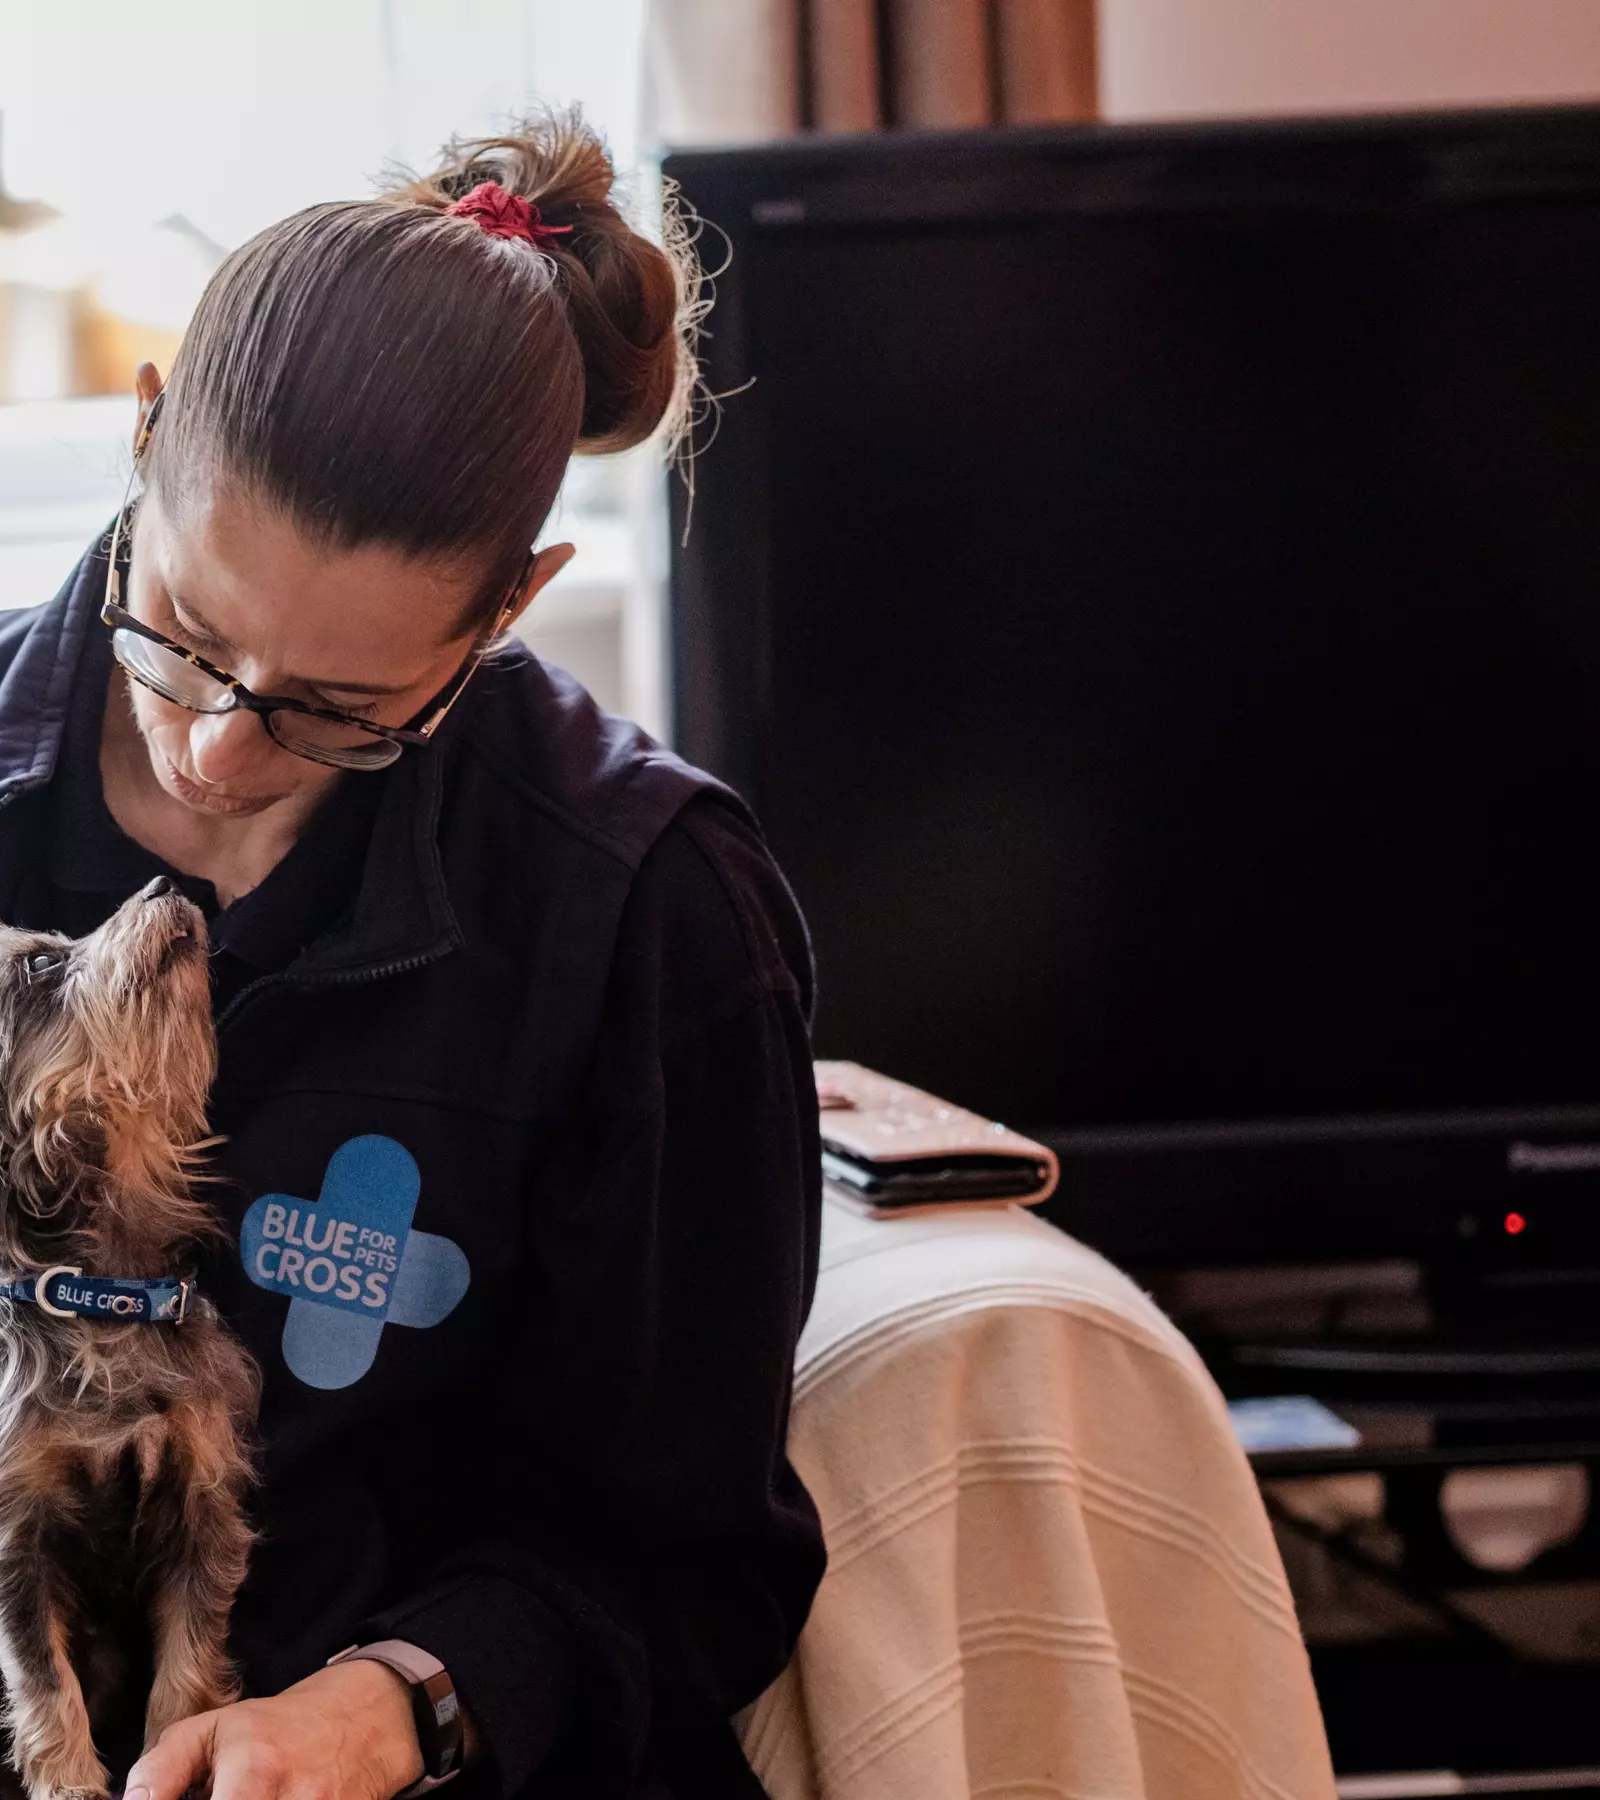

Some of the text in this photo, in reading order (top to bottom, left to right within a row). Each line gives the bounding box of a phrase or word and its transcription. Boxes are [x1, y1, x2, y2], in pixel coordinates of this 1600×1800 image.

[262, 1203, 357, 1260] BLUE
[359, 1228, 397, 1253] FOR
[353, 1249, 397, 1273] PETS
[256, 1243, 389, 1308] CROSS
[57, 1284, 93, 1307] BLUE
